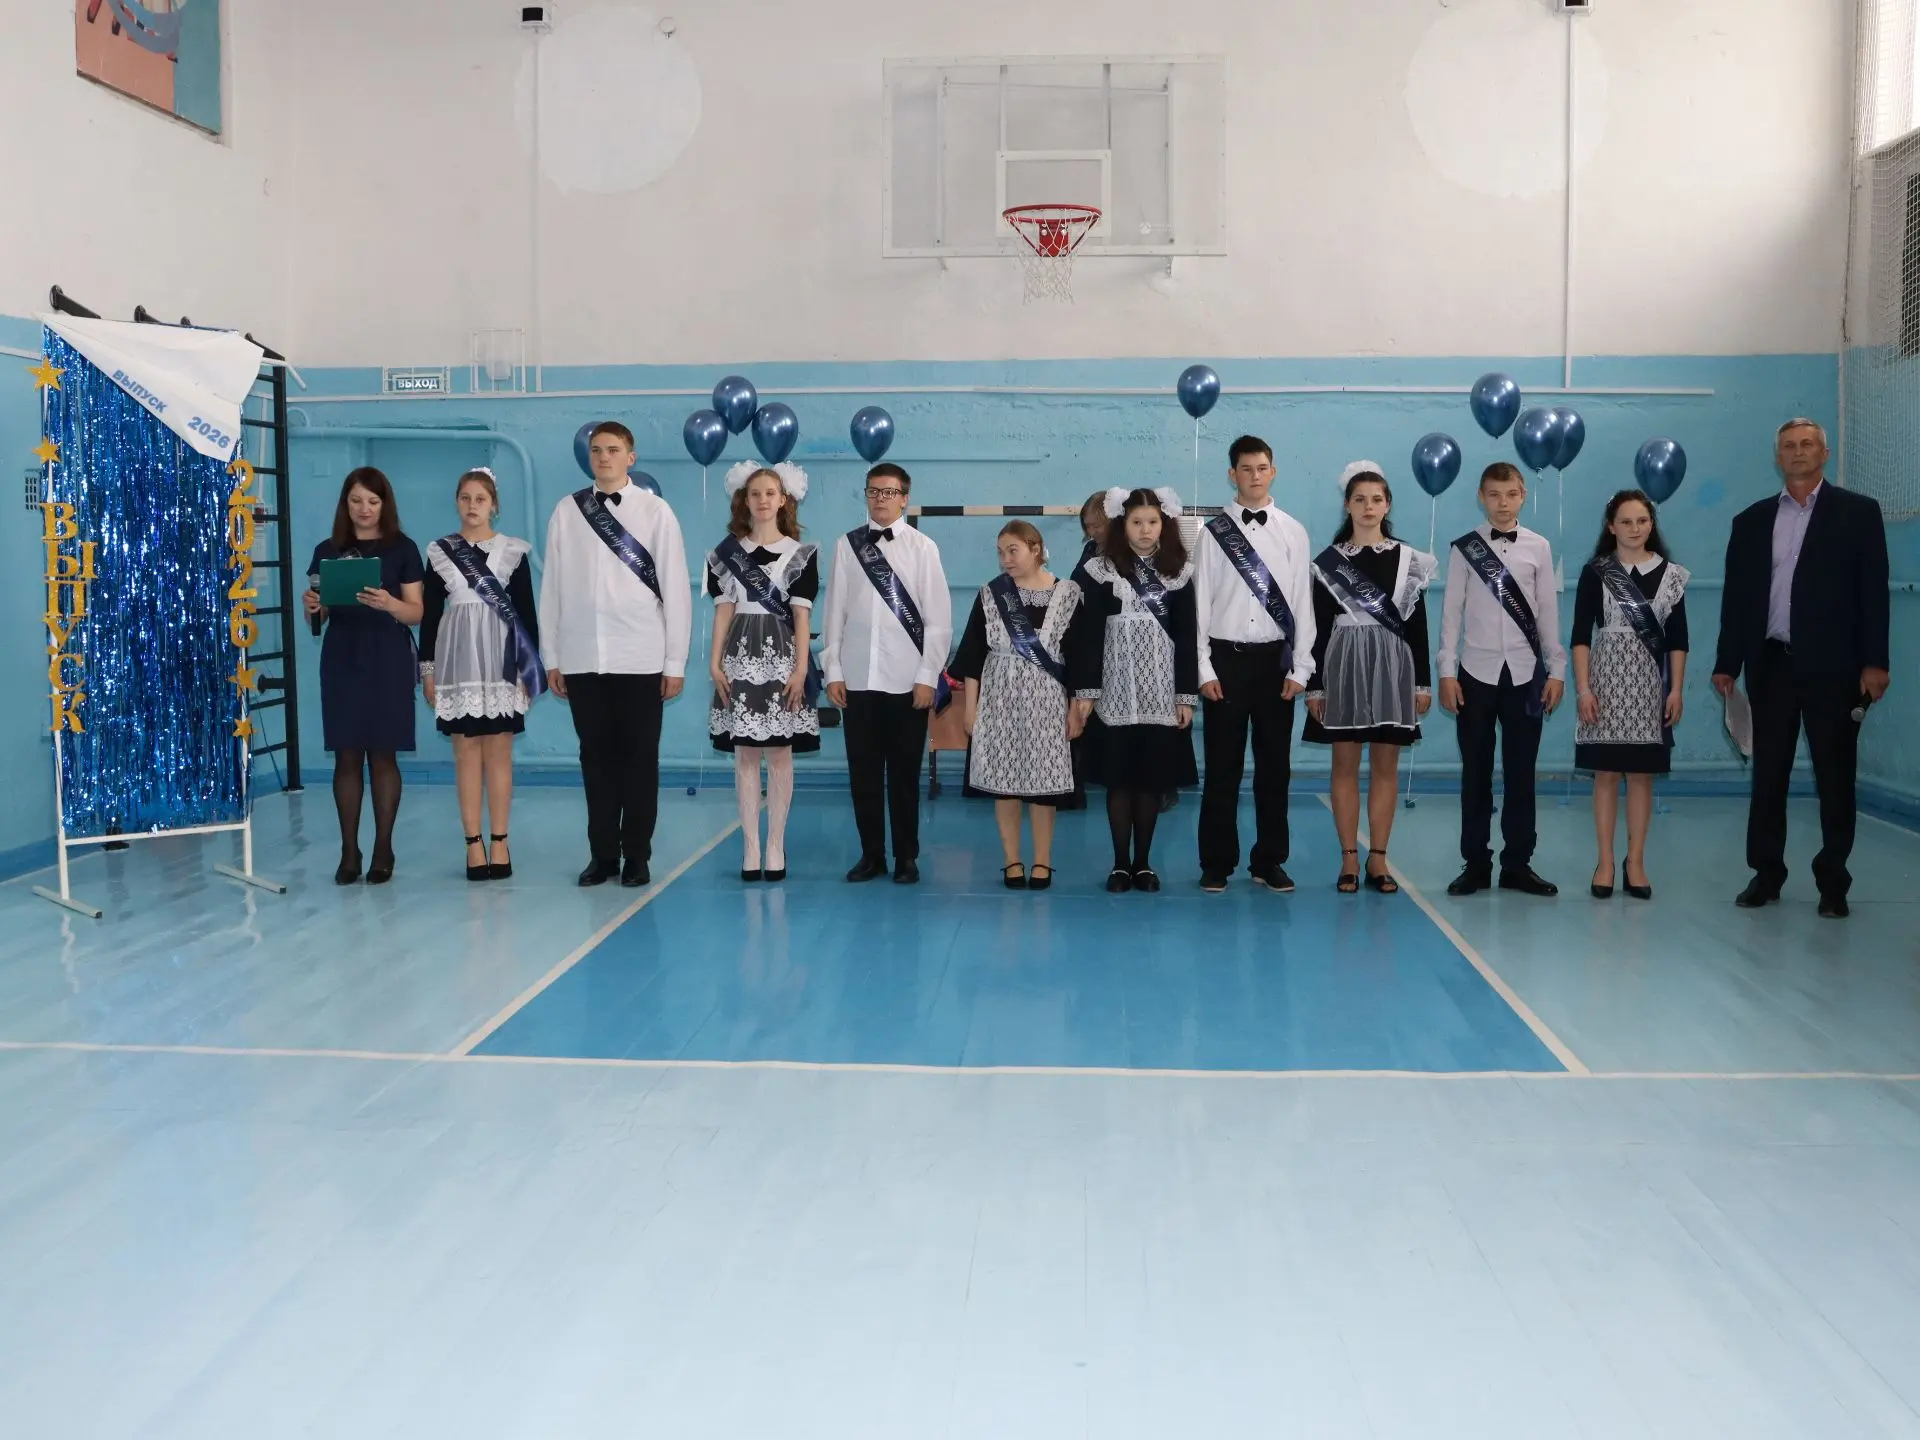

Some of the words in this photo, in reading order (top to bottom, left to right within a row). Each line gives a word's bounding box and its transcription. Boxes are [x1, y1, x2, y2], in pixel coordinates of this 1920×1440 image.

[187, 416, 231, 449] 2026
[398, 378, 438, 390] ВЫХОД
[226, 459, 259, 649] 2026
[39, 502, 98, 733] ВЫПУСК
